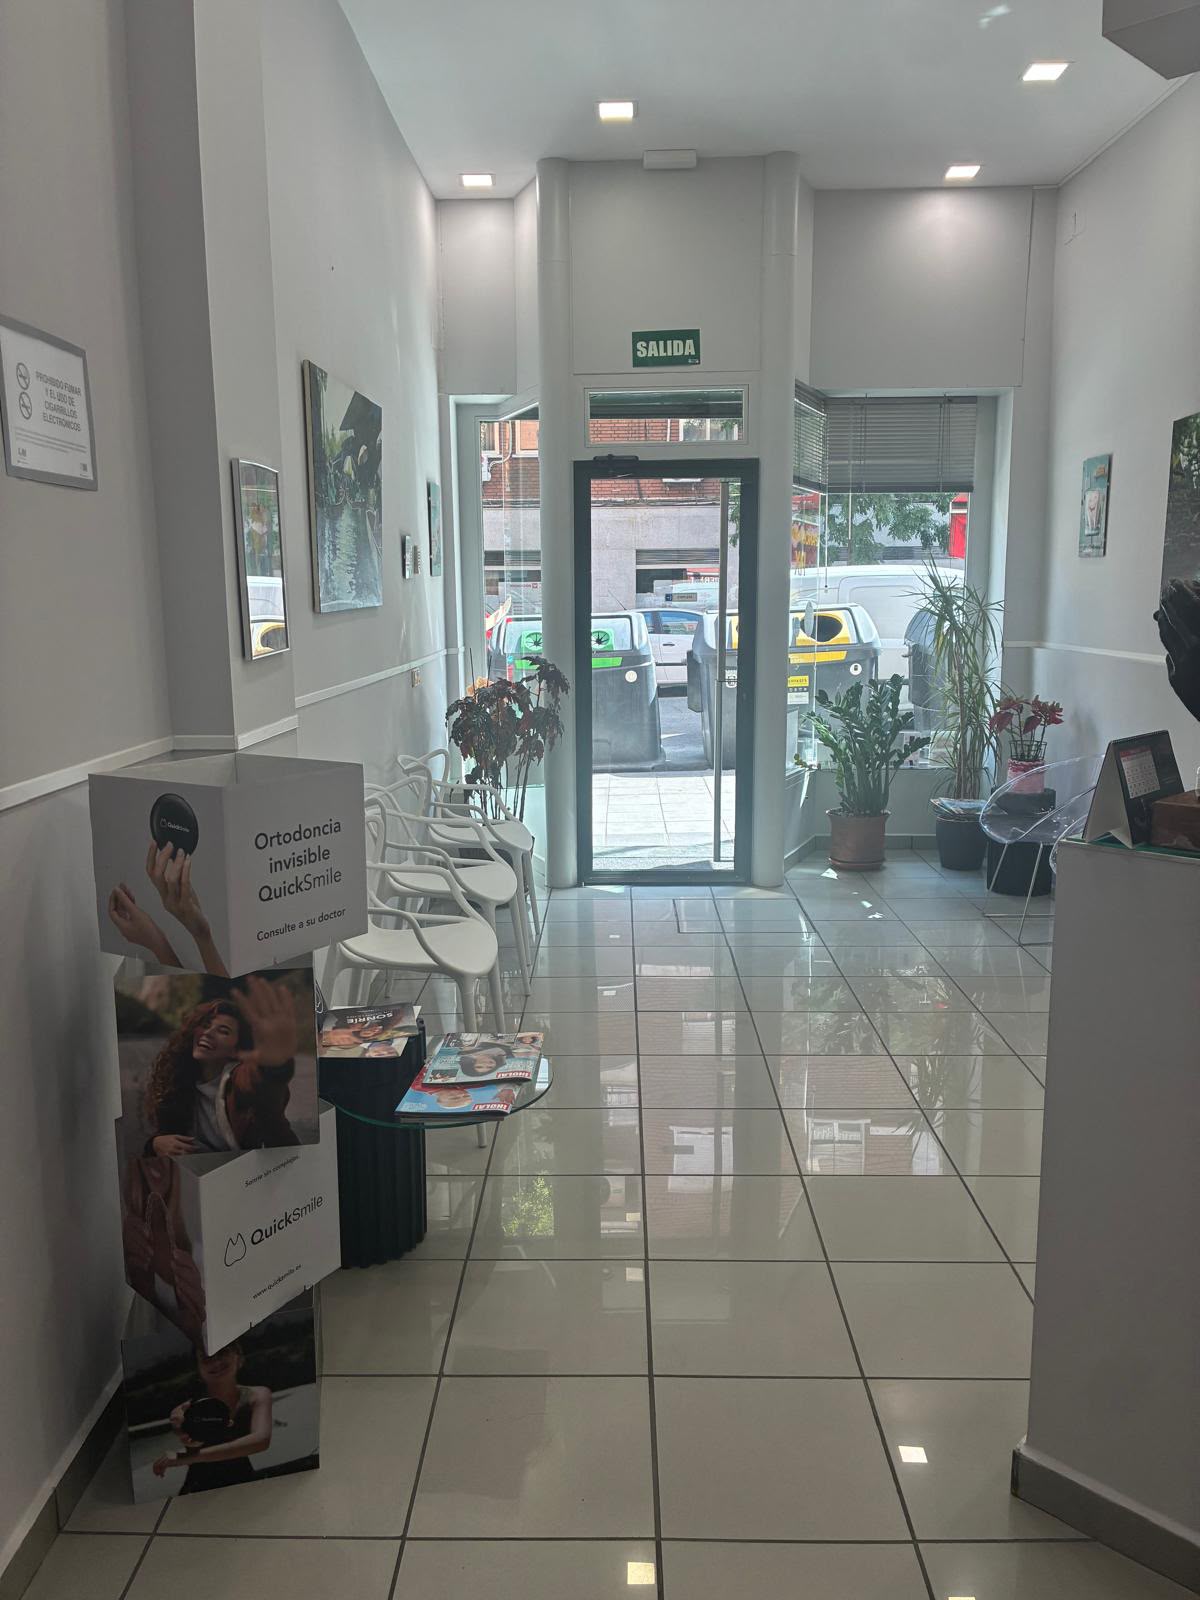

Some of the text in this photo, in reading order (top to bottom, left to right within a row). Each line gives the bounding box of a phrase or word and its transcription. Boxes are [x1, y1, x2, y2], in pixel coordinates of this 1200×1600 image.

[636, 339, 696, 358] SALIDA
[254, 818, 341, 850] Ortodoncia
[269, 846, 331, 874] invisible
[258, 867, 342, 902] QuickSmile
[256, 907, 346, 941] Consulte a su doctor
[250, 1195, 324, 1245] QuickSmile
